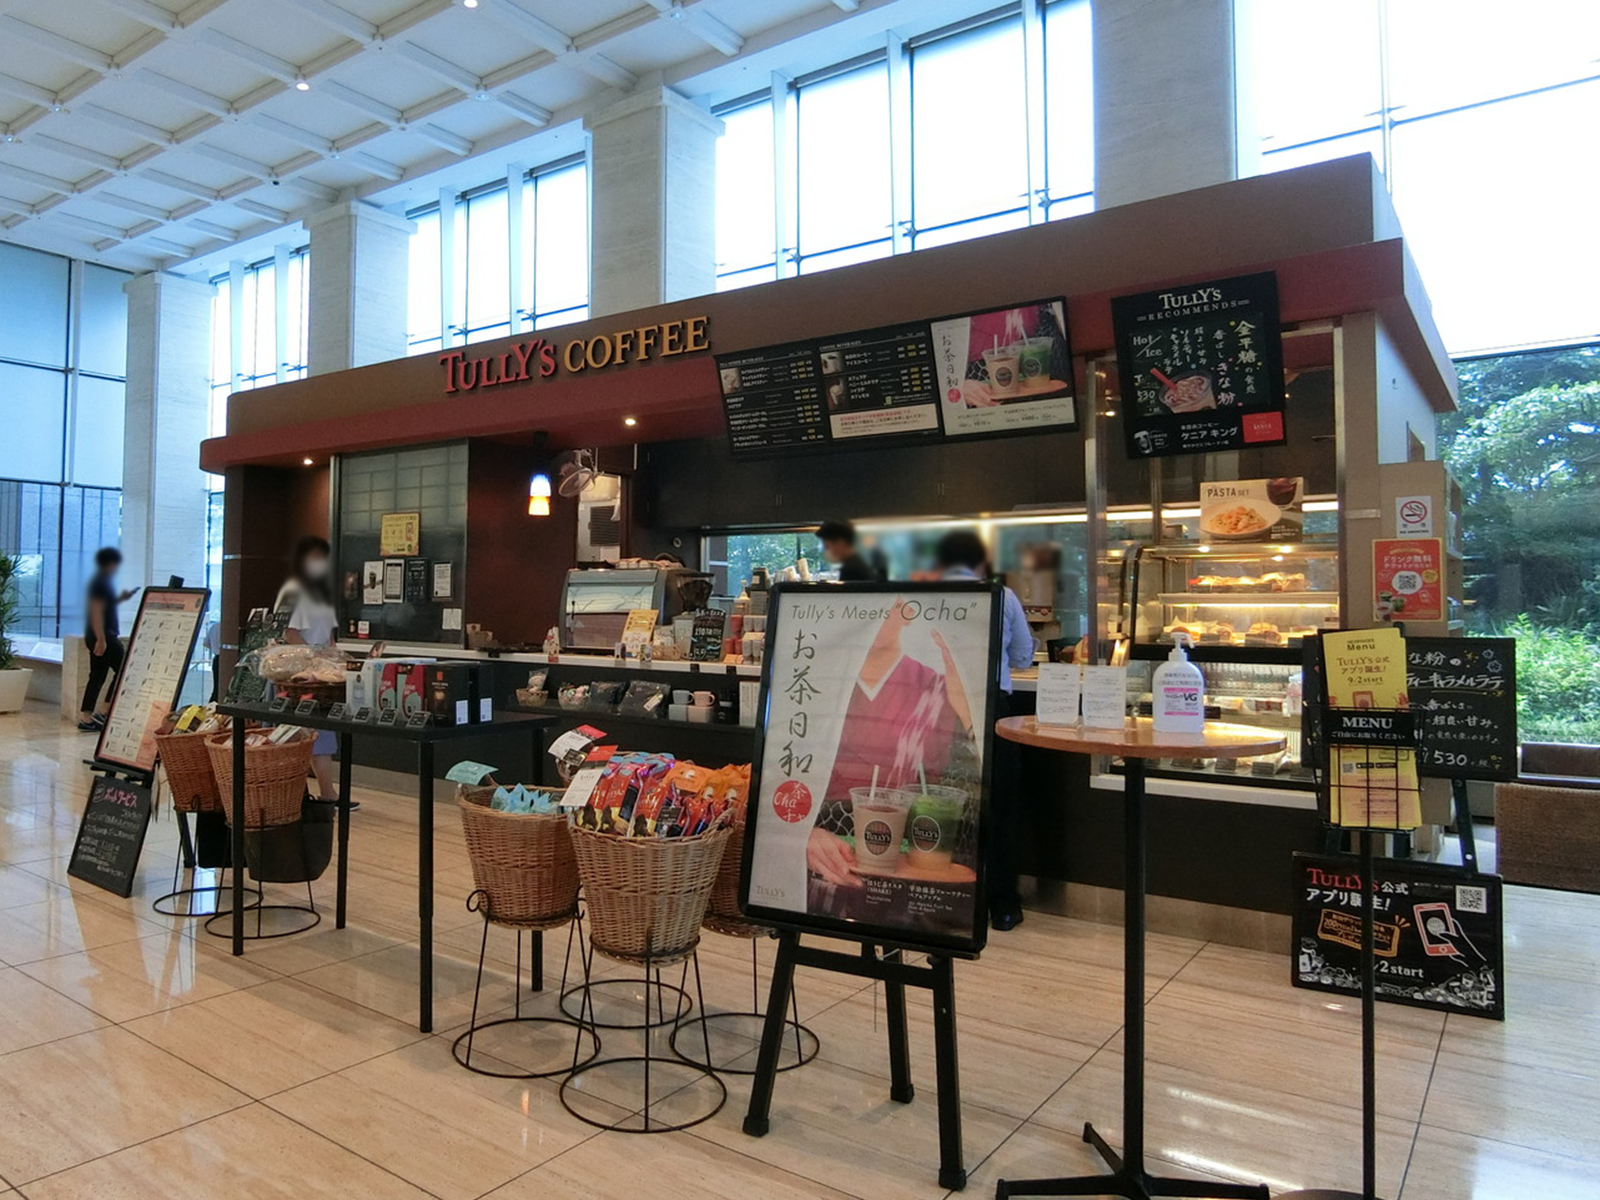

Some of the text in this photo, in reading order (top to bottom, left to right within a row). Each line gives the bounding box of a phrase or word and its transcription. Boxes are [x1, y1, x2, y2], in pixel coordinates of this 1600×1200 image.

[1148, 300, 1237, 320] RECOMMENDS
[564, 316, 709, 372] COFFEE
[1133, 334, 1154, 346] Hot
[1146, 348, 1163, 357] Ice
[1181, 430, 1207, 441] ケニア
[1210, 426, 1238, 438] キング
[1207, 487, 1236, 498] PASTA
[791, 605, 835, 623] Tully's
[841, 605, 890, 619] Meets
[779, 628, 822, 777] お茶日和
[1183, 693, 1198, 702] VG
[1342, 716, 1393, 729] MENU
[1433, 750, 1467, 766] 530
[1381, 881, 1409, 895] 公式
[1390, 965, 1424, 978] start
